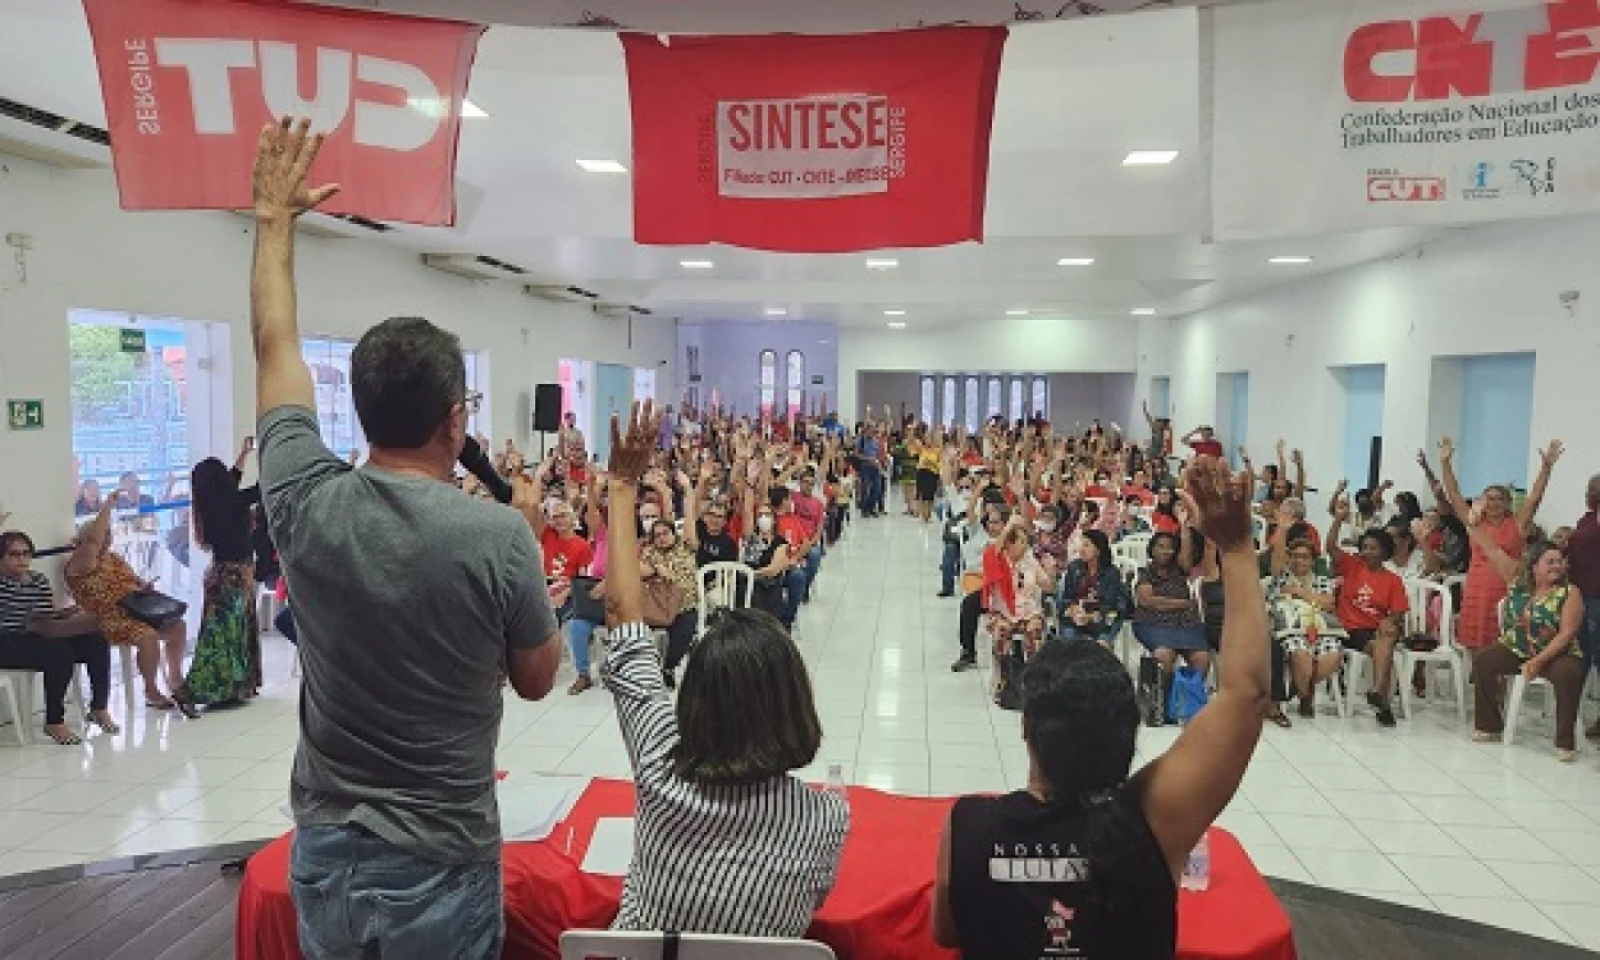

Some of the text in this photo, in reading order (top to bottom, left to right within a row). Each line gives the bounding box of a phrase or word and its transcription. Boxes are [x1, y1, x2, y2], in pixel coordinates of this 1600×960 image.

[727, 100, 886, 152] SINTESE
[1341, 92, 1600, 129] Confederação Nacional dos
[889, 106, 906, 178] SERGIPE
[1342, 113, 1598, 148] Trabalhadores em Educação
[1368, 177, 1441, 201] CUT
[994, 843, 1080, 856] NOSSA
